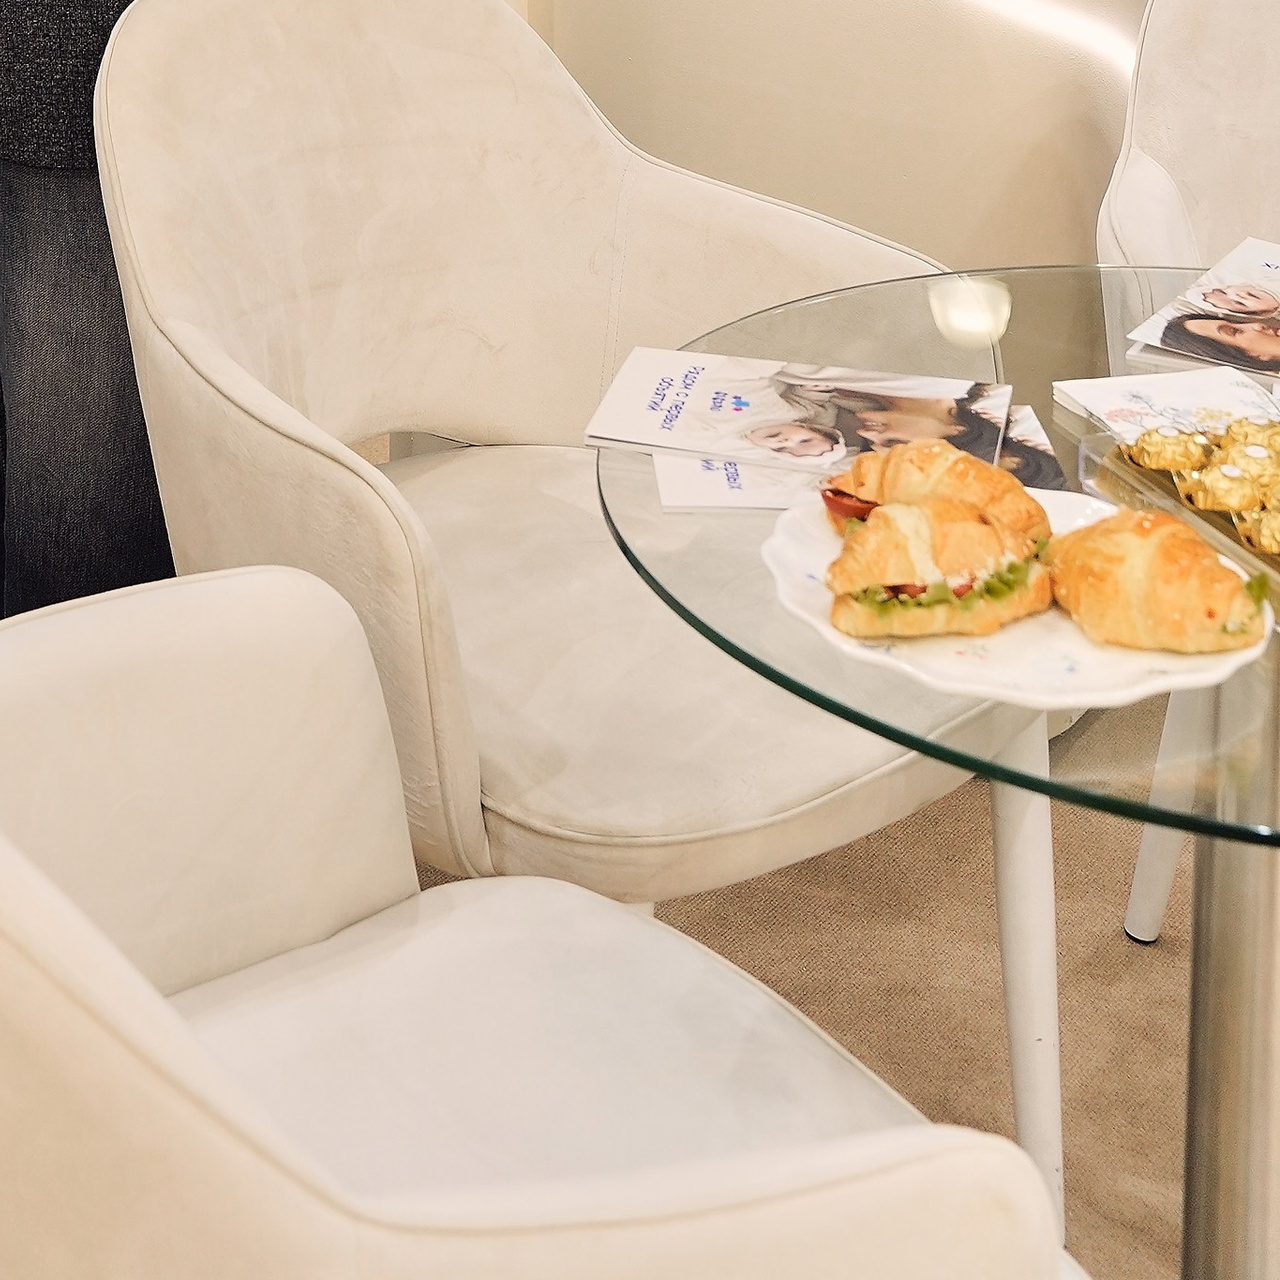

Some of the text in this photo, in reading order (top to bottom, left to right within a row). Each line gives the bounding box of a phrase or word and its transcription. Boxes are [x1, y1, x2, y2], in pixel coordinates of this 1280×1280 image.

[646, 376, 674, 412] объятий
[660, 399, 686, 432] первых
[723, 462, 743, 490] ервых
